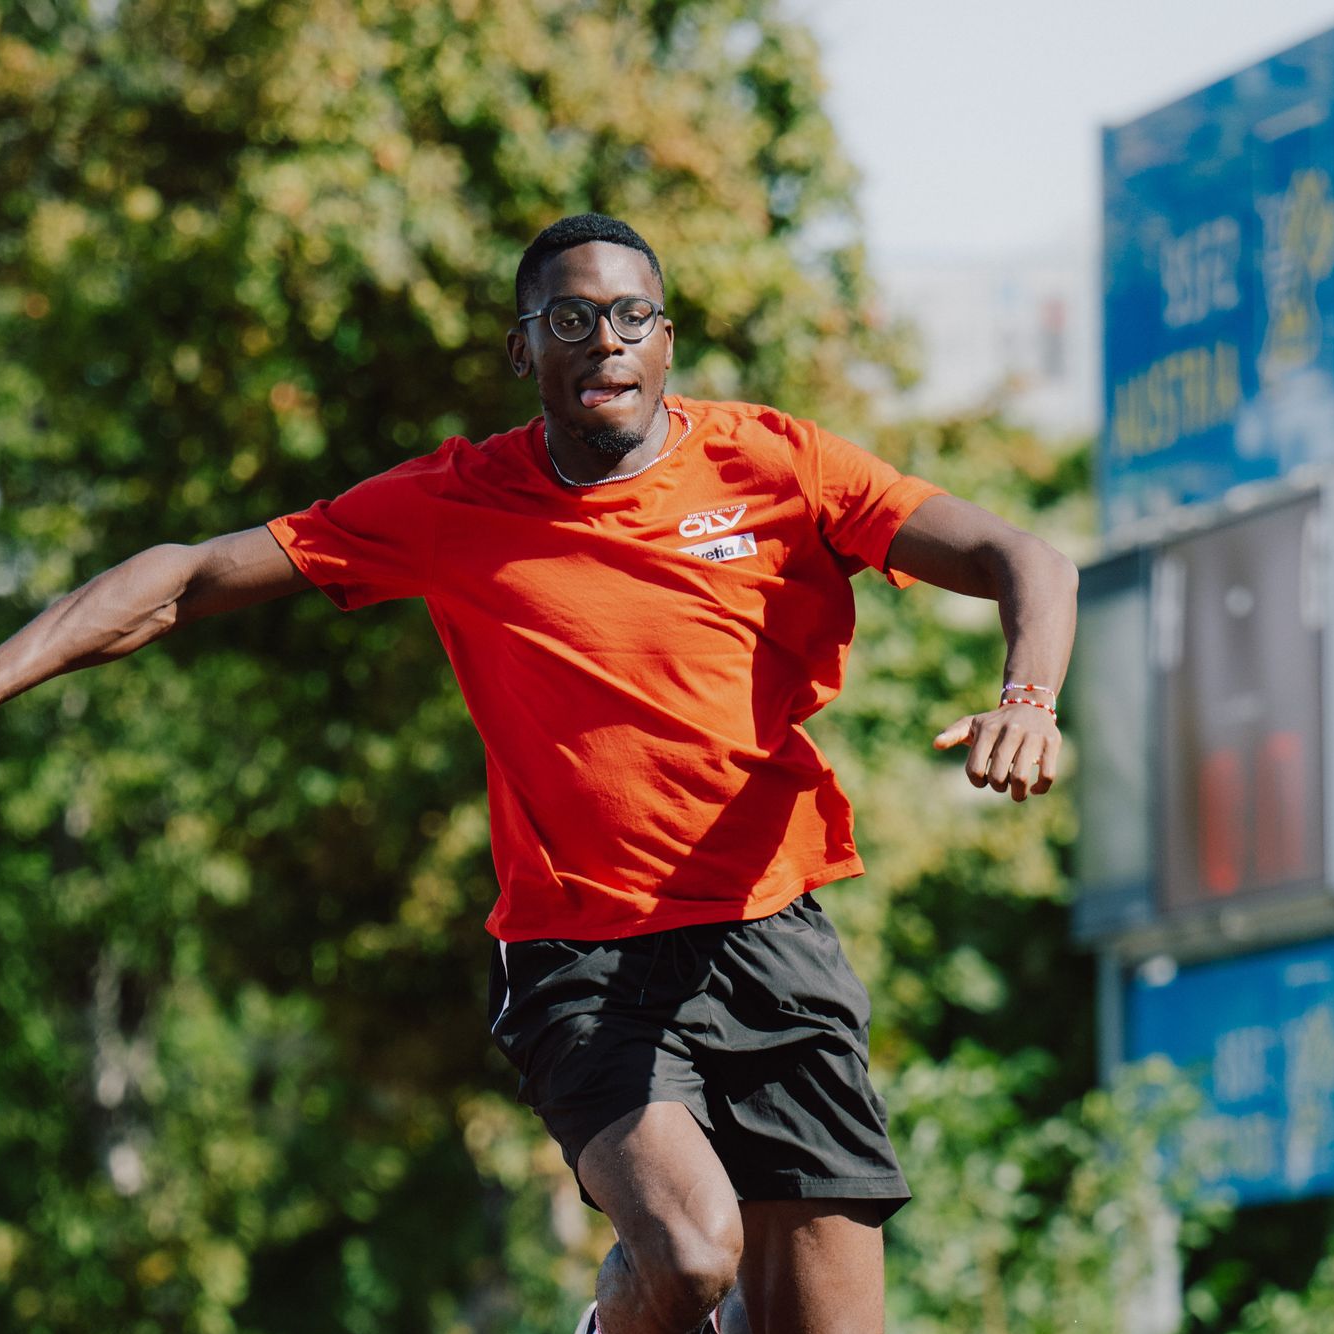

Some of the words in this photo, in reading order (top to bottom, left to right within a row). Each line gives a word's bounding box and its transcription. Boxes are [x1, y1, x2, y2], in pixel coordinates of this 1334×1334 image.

[687, 509, 715, 520] AUSTRIAN
[716, 503, 747, 514] ATHLETICS
[690, 544, 735, 561] etia
